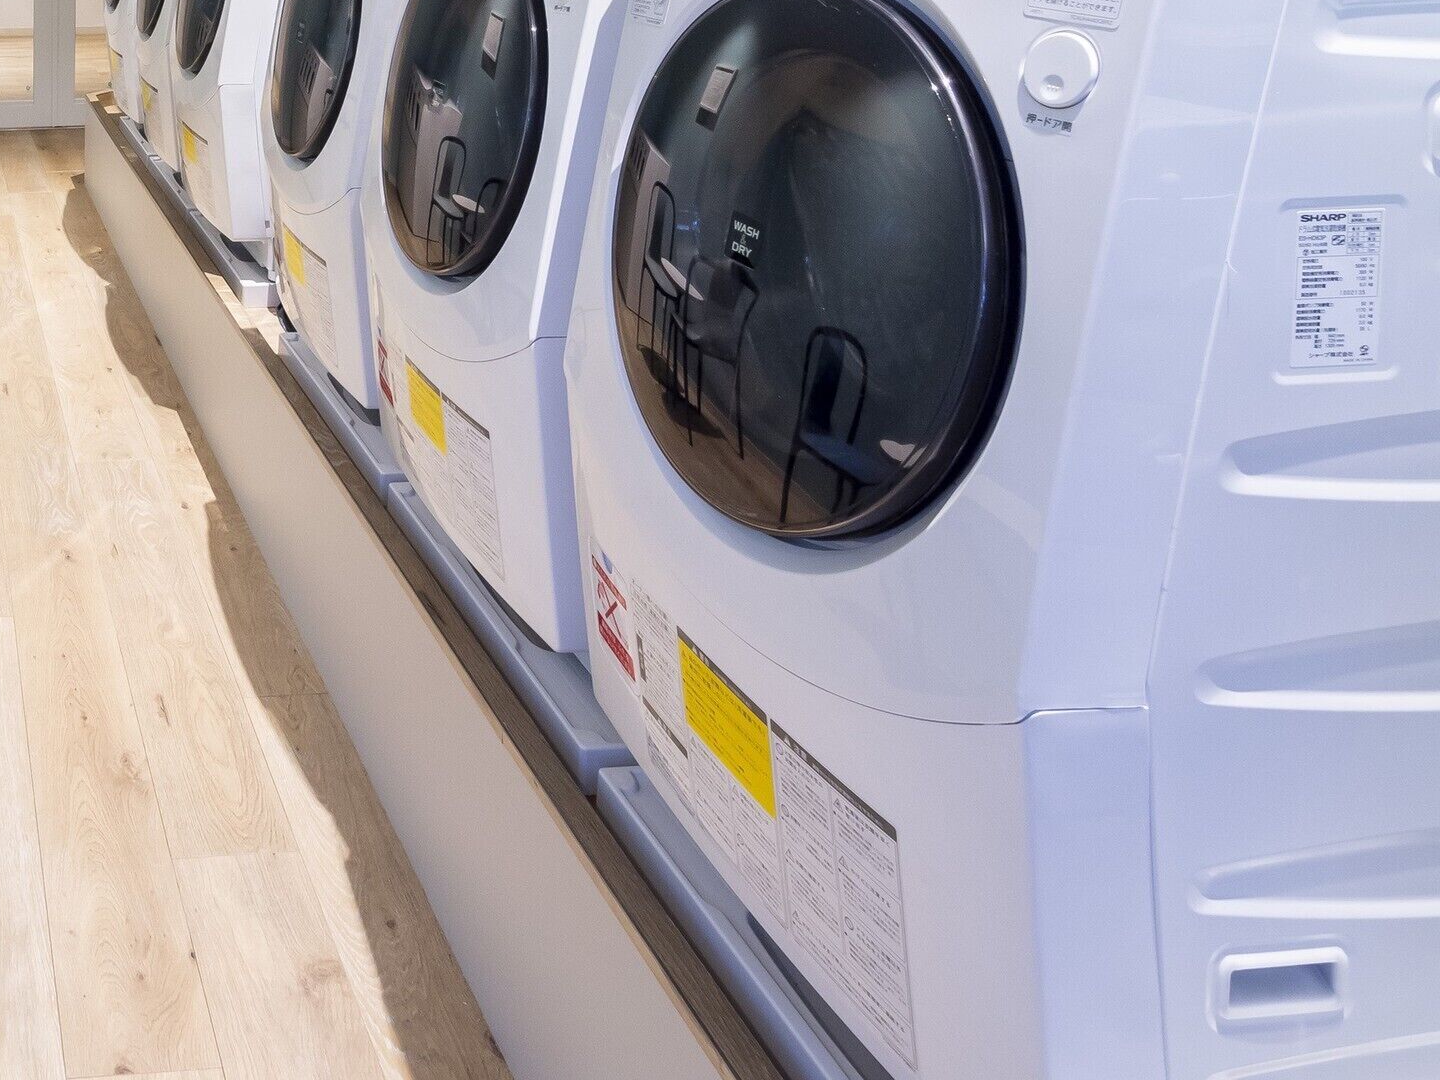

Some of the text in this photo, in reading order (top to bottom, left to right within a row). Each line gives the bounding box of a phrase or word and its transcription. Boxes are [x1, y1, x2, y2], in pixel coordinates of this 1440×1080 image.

[1300, 213, 1347, 222] SHARP
[733, 219, 760, 240] WASH
[731, 241, 753, 258] DRY
